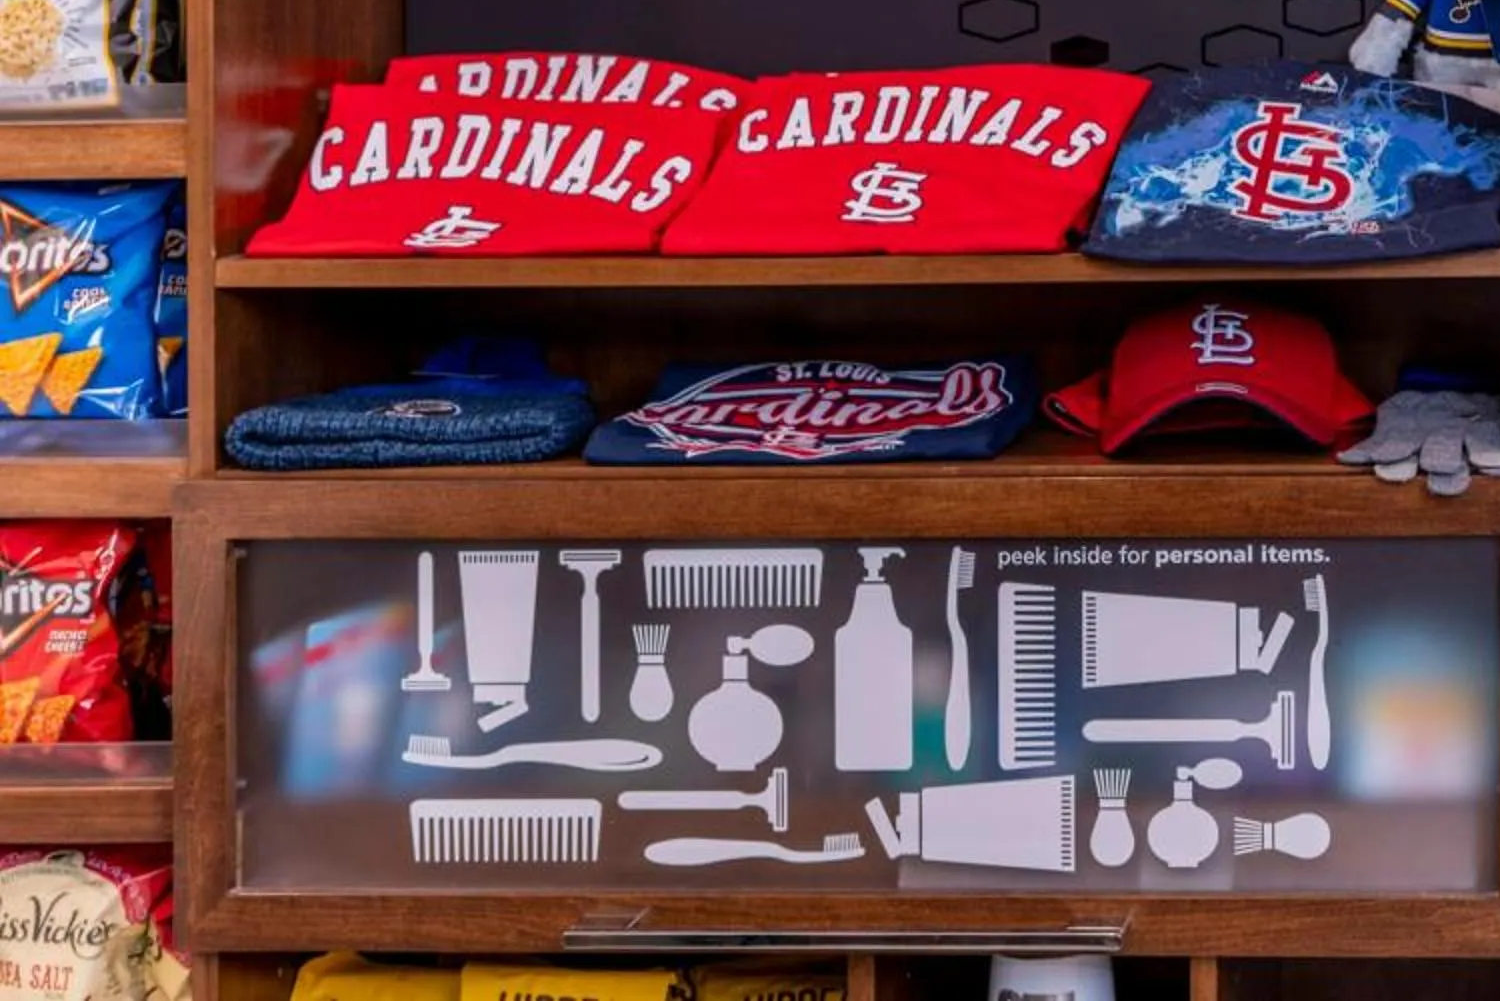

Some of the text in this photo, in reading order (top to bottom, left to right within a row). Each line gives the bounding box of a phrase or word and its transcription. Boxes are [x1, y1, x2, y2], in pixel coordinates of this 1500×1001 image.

[737, 86, 1107, 168] CARDINALS
[309, 114, 692, 213] CARDINALS
[0, 232, 110, 272] oritos
[776, 362, 891, 385] ST. LOUIS
[998, 544, 1331, 569] peek inside for personal items.
[0, 579, 92, 615] ritos
[0, 911, 31, 941] iss
[30, 963, 74, 991] SALT
